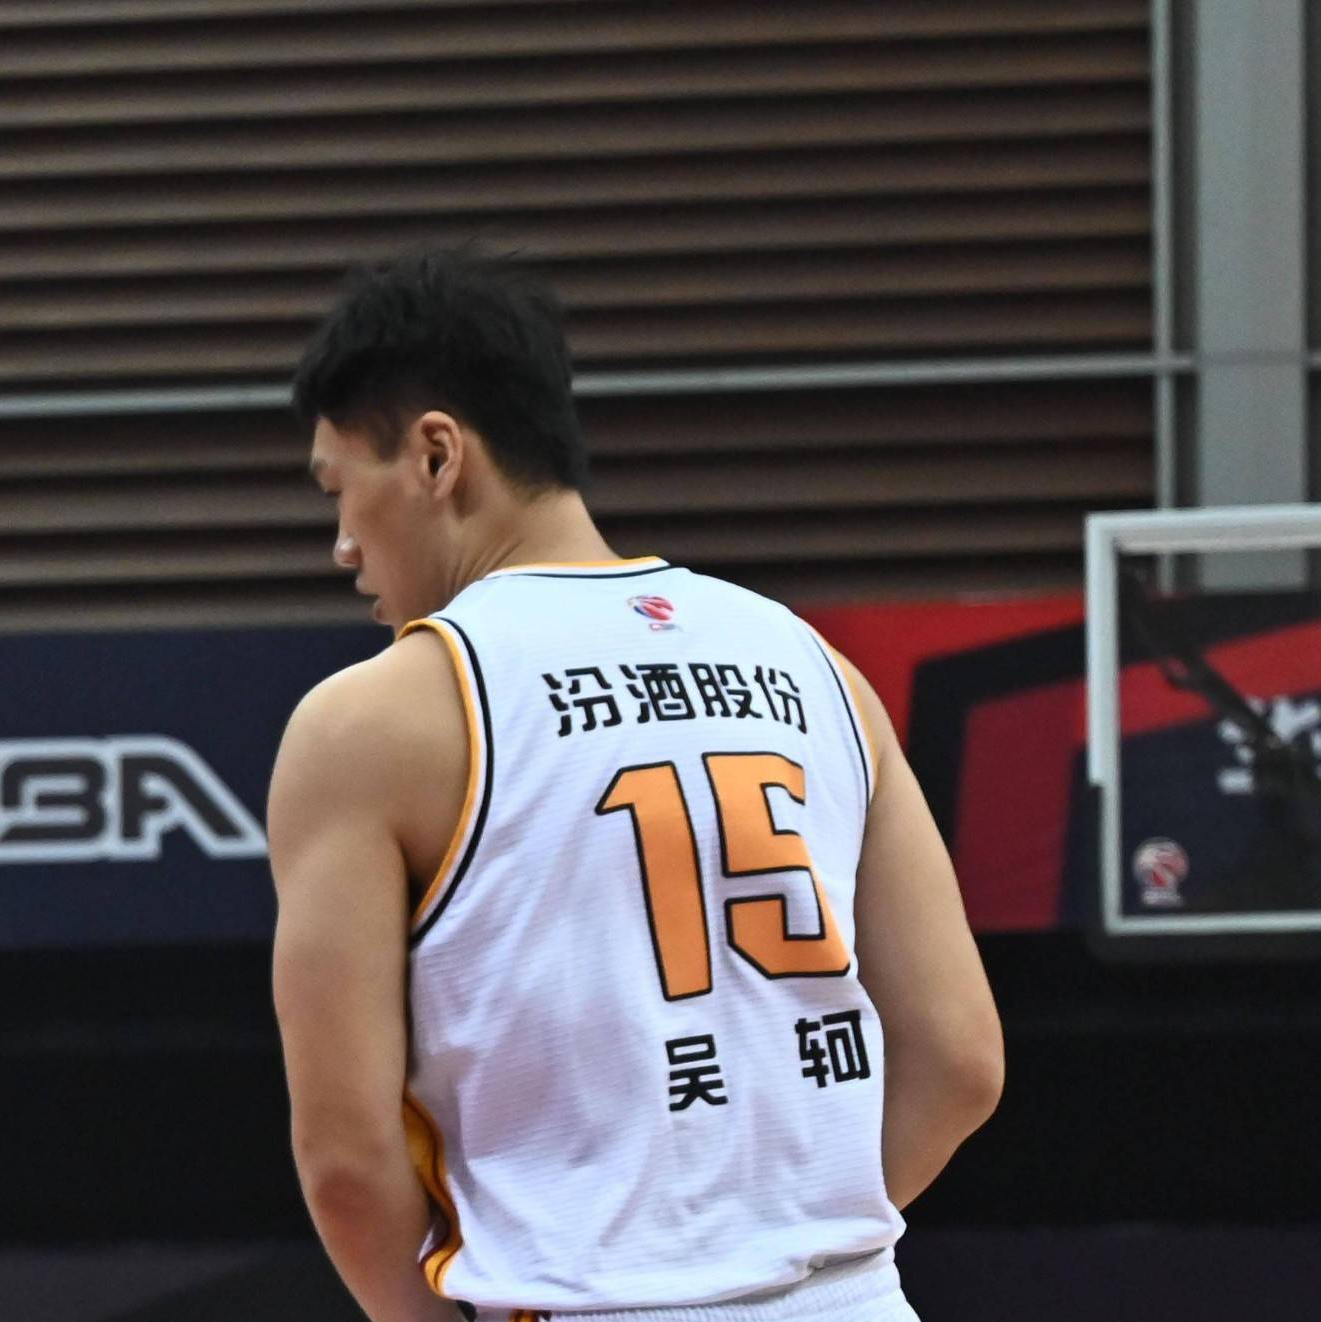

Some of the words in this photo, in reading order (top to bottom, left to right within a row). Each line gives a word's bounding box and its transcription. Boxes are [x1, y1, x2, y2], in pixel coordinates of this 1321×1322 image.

[540, 661, 808, 738] 汾酒股份
[594, 751, 850, 1001] 15
